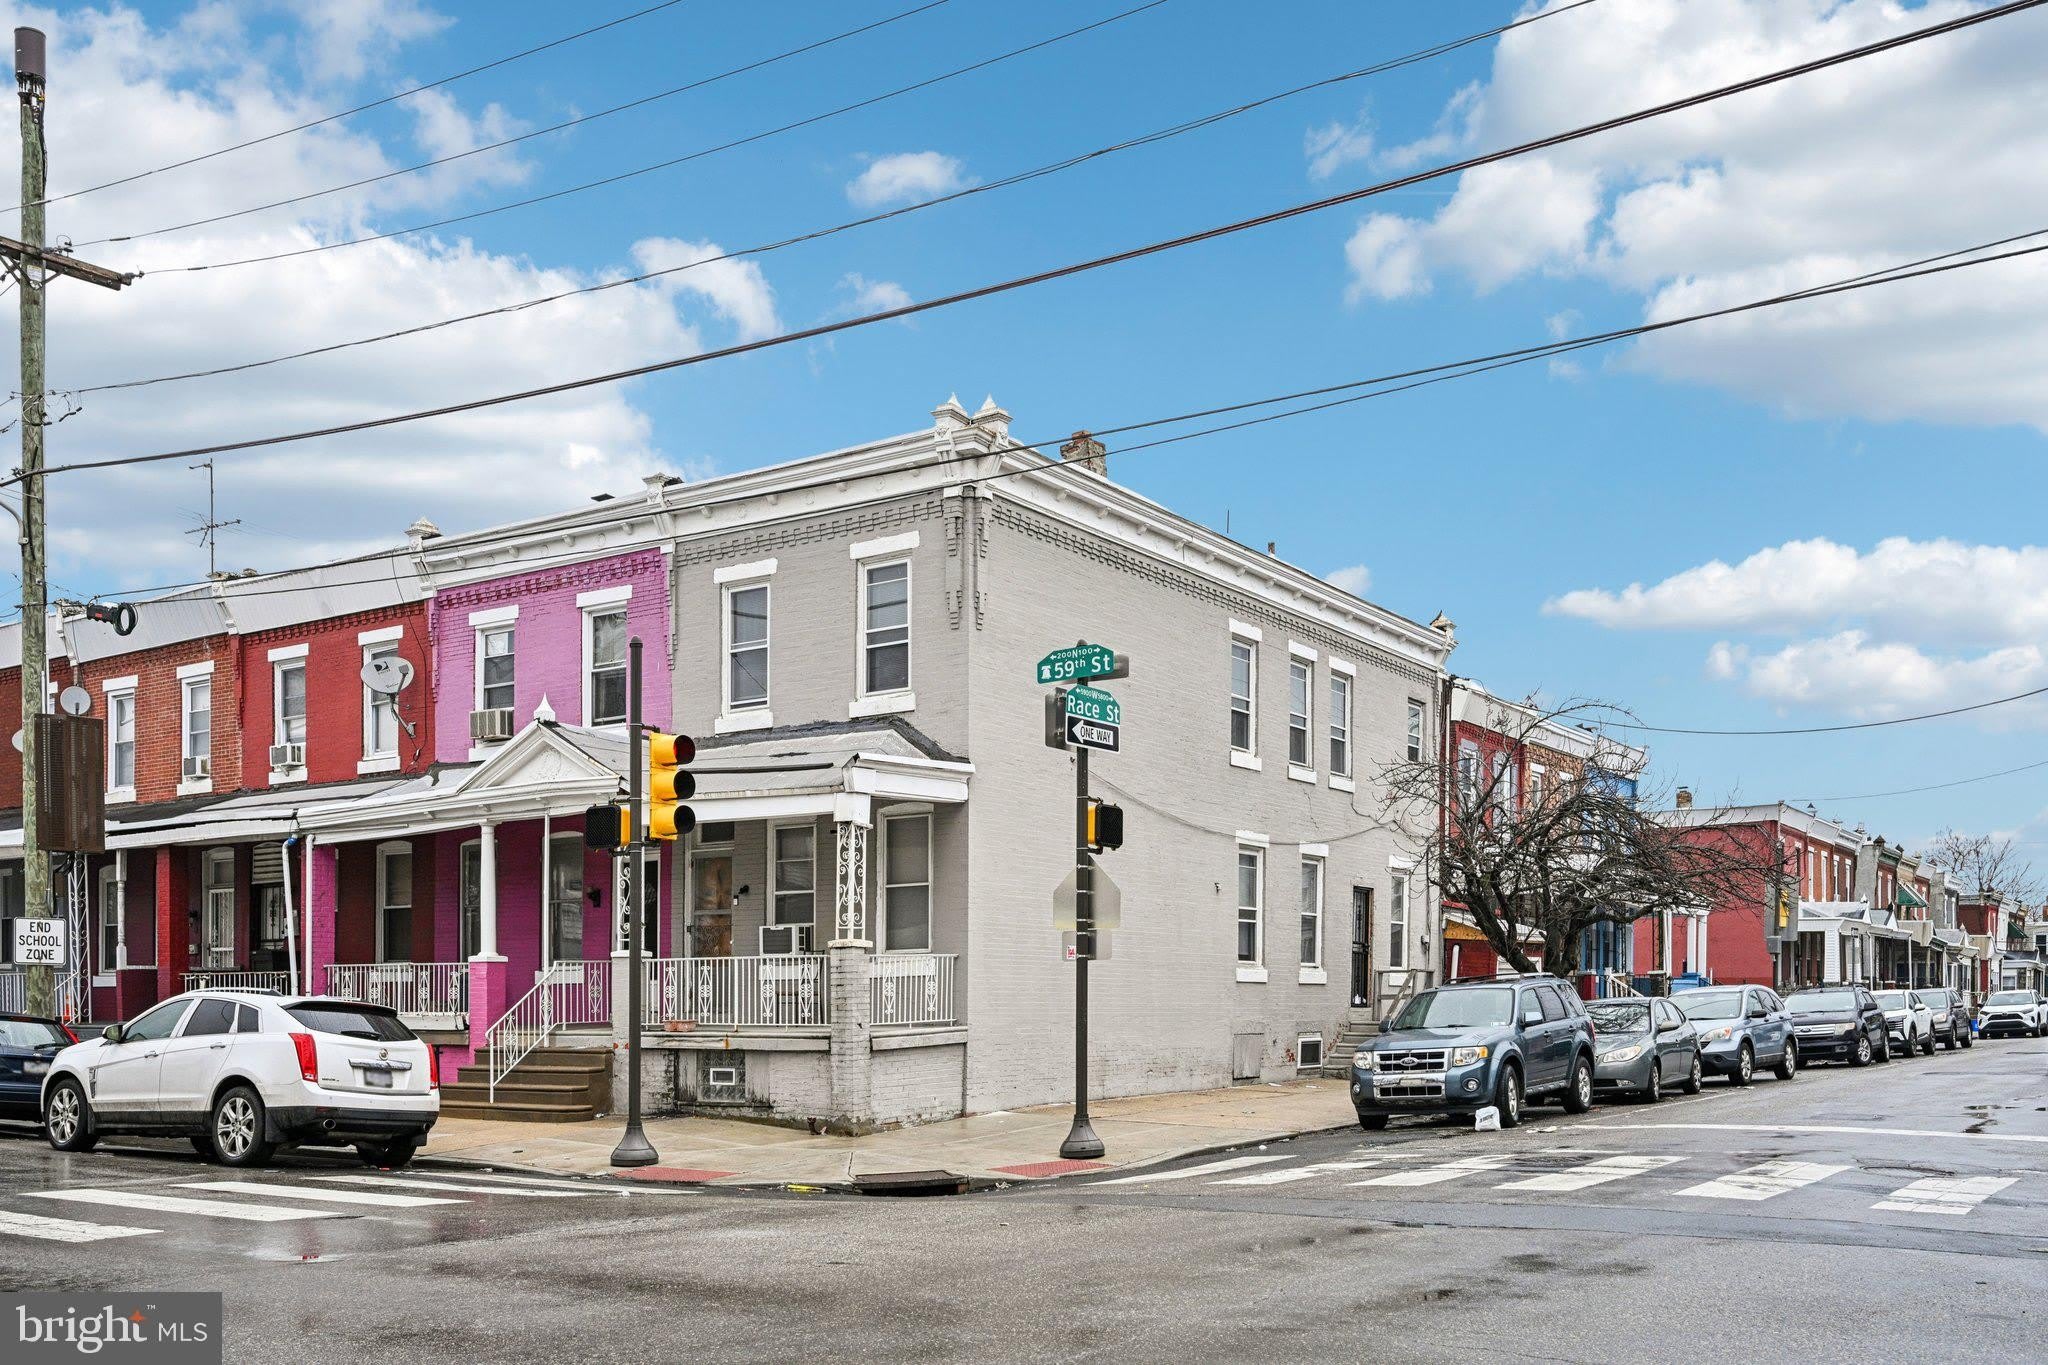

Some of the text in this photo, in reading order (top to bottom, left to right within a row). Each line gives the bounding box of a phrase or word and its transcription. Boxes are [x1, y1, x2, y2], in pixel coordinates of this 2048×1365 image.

[1054, 654, 1111, 678] 59th St
[1067, 695, 1120, 723] Race St
[1080, 726, 1111, 743] ONE WAY
[29, 921, 51, 933] END
[18, 935, 61, 947] SCHOOL
[26, 949, 54, 960] ZONE
